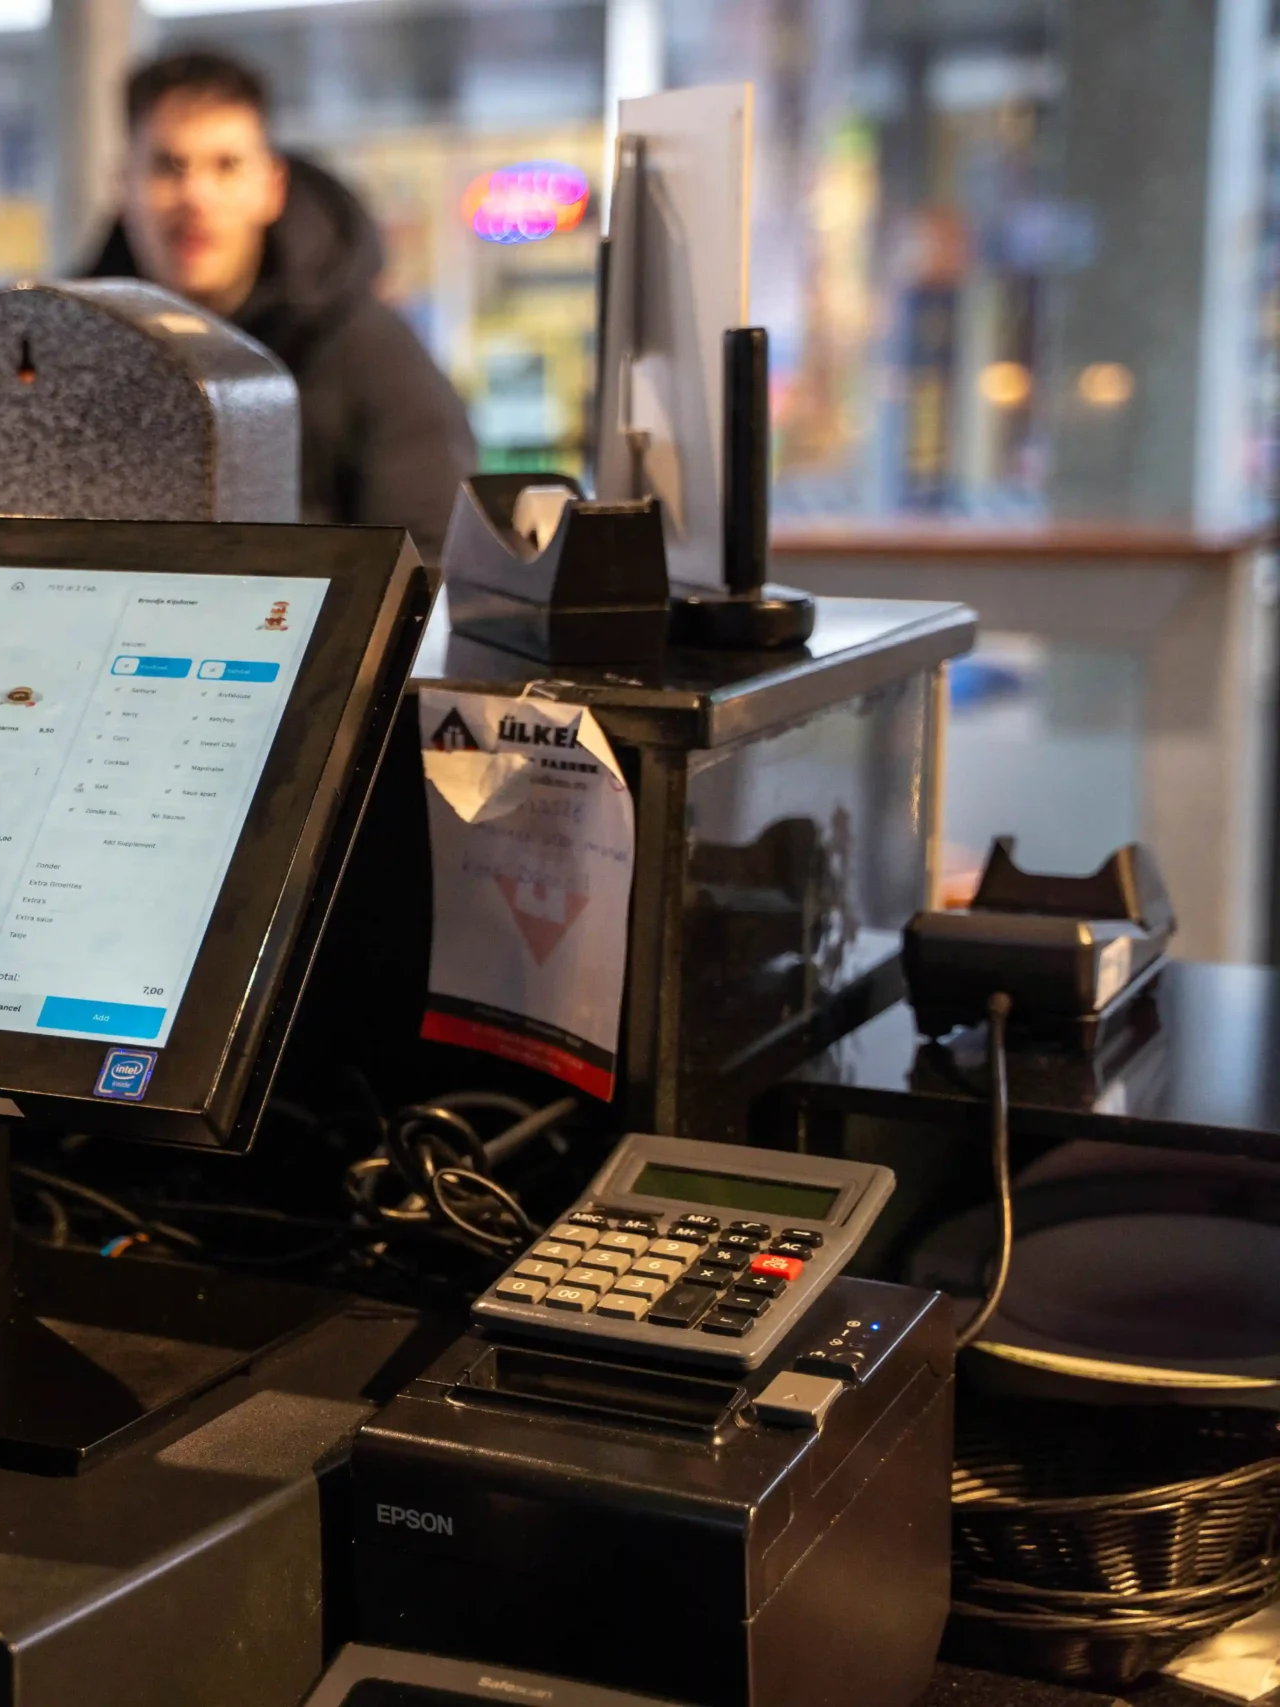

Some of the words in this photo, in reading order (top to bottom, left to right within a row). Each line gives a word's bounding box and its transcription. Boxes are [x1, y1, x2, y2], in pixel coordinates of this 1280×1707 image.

[138, 597, 164, 606] Broodje
[209, 716, 235, 725] Ketchup
[200, 740, 219, 748] Sweet
[104, 758, 130, 767] Cocktail
[199, 791, 217, 800] apart
[85, 807, 106, 816] Zonder
[102, 837, 115, 846] Add
[116, 839, 157, 851] Supplement
[36, 861, 61, 871] Zonder
[28, 878, 48, 888] Extra
[50, 880, 82, 891] Groentes
[22, 896, 47, 906] Extra's
[15, 913, 35, 923] Extra
[36, 915, 54, 924] saus
[9, 931, 28, 941] Tasje
[142, 986, 165, 997] 7,00
[92, 1013, 111, 1023] Add
[115, 1064, 138, 1075] intel
[571, 1211, 602, 1223] MRC
[686, 1214, 711, 1224] MU
[565, 1227, 580, 1237] 7
[676, 1227, 697, 1237] M+
[614, 1235, 629, 1245] 8
[728, 1235, 748, 1244] GT
[546, 1245, 560, 1255] 4
[666, 1242, 679, 1252] 9
[779, 1242, 802, 1252] AC
[596, 1252, 612, 1263] 5
[648, 1260, 662, 1270] 6
[582, 1271, 594, 1282] 2
[513, 1281, 527, 1291] 0
[632, 1279, 645, 1289] 3
[557, 1289, 581, 1300] 00
[376, 1503, 454, 1536] EPSON
